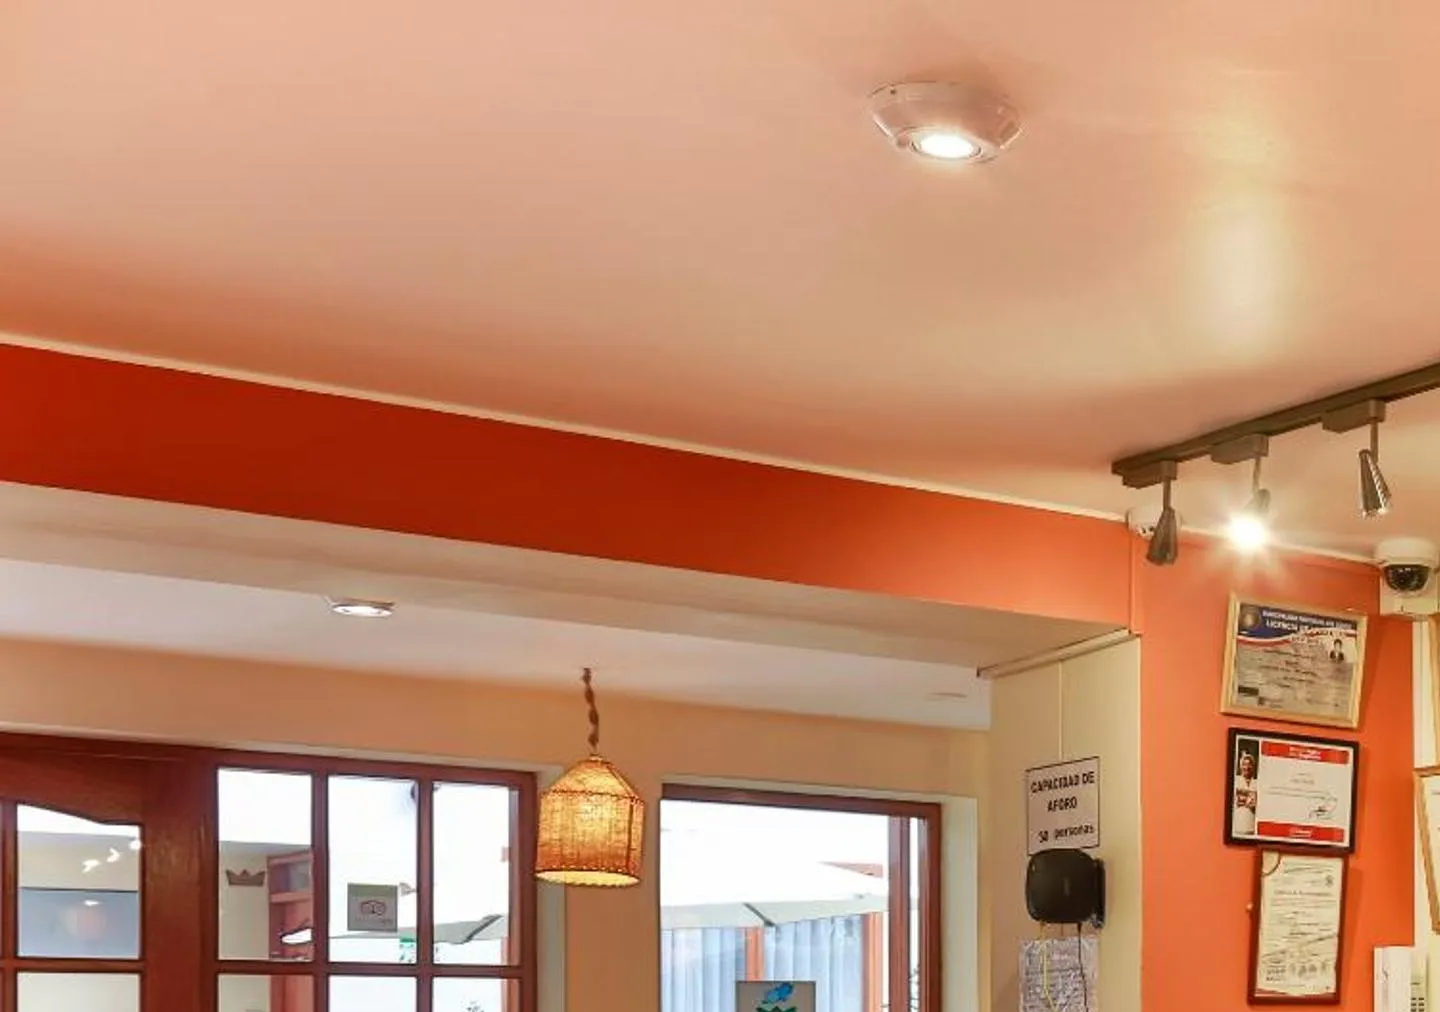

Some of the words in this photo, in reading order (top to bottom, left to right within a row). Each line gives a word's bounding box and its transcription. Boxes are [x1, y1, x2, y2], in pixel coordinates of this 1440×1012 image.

[1030, 774, 1080, 794] CAPACIDAD
[1082, 770, 1095, 784] DE
[1047, 796, 1078, 812] AFORO
[1054, 824, 1095, 840] personas
